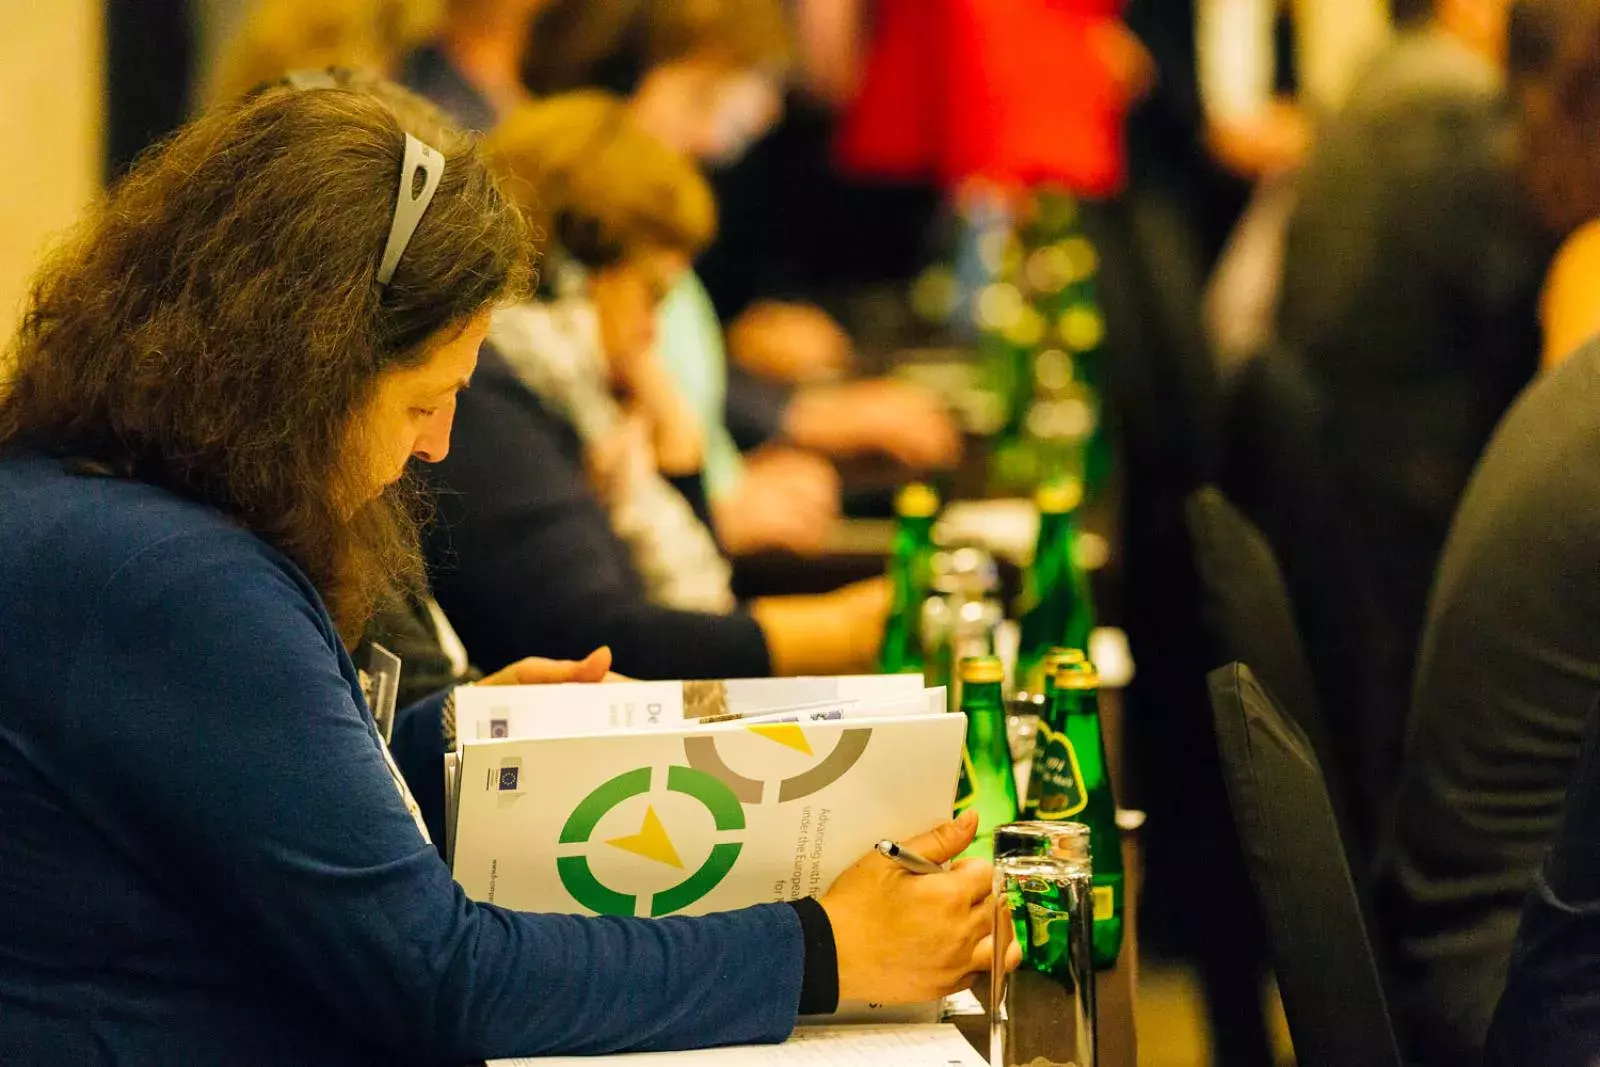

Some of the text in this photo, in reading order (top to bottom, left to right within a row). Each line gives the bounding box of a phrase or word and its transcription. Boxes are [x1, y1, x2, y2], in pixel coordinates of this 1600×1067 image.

[800, 806, 811, 834] under
[796, 837, 809, 853] the
[810, 808, 831, 859] Advancing
[809, 861, 820, 884] with
[774, 880, 787, 895] for
